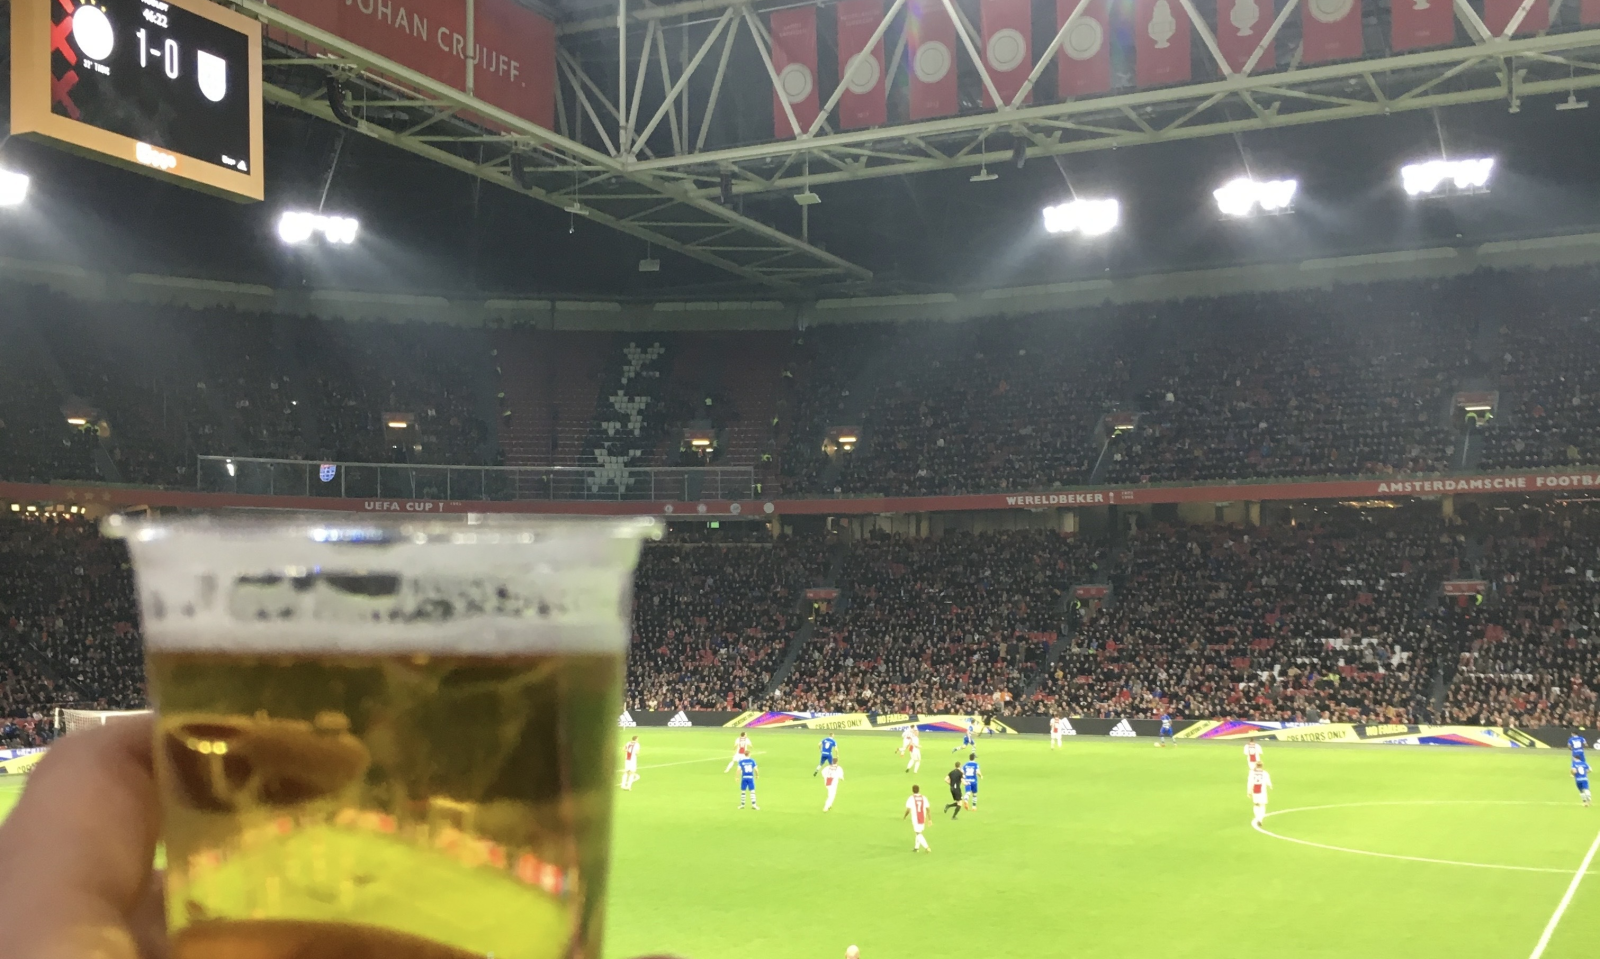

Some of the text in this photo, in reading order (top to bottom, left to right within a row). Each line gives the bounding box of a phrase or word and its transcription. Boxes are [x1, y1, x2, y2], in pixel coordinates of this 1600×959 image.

[345, 0, 427, 42] OHAN
[135, 28, 178, 79] 1-0
[1377, 477, 1526, 493] AMSTERDAMSCHE
[1006, 493, 1104, 506] WERELDBEKER
[364, 501, 433, 511] UEFA CUP
[815, 719, 863, 730] CREATORS ONLY
[876, 715, 887, 724] NO
[1286, 730, 1347, 742] CREATORS ONLY
[1365, 726, 1378, 736] NO
